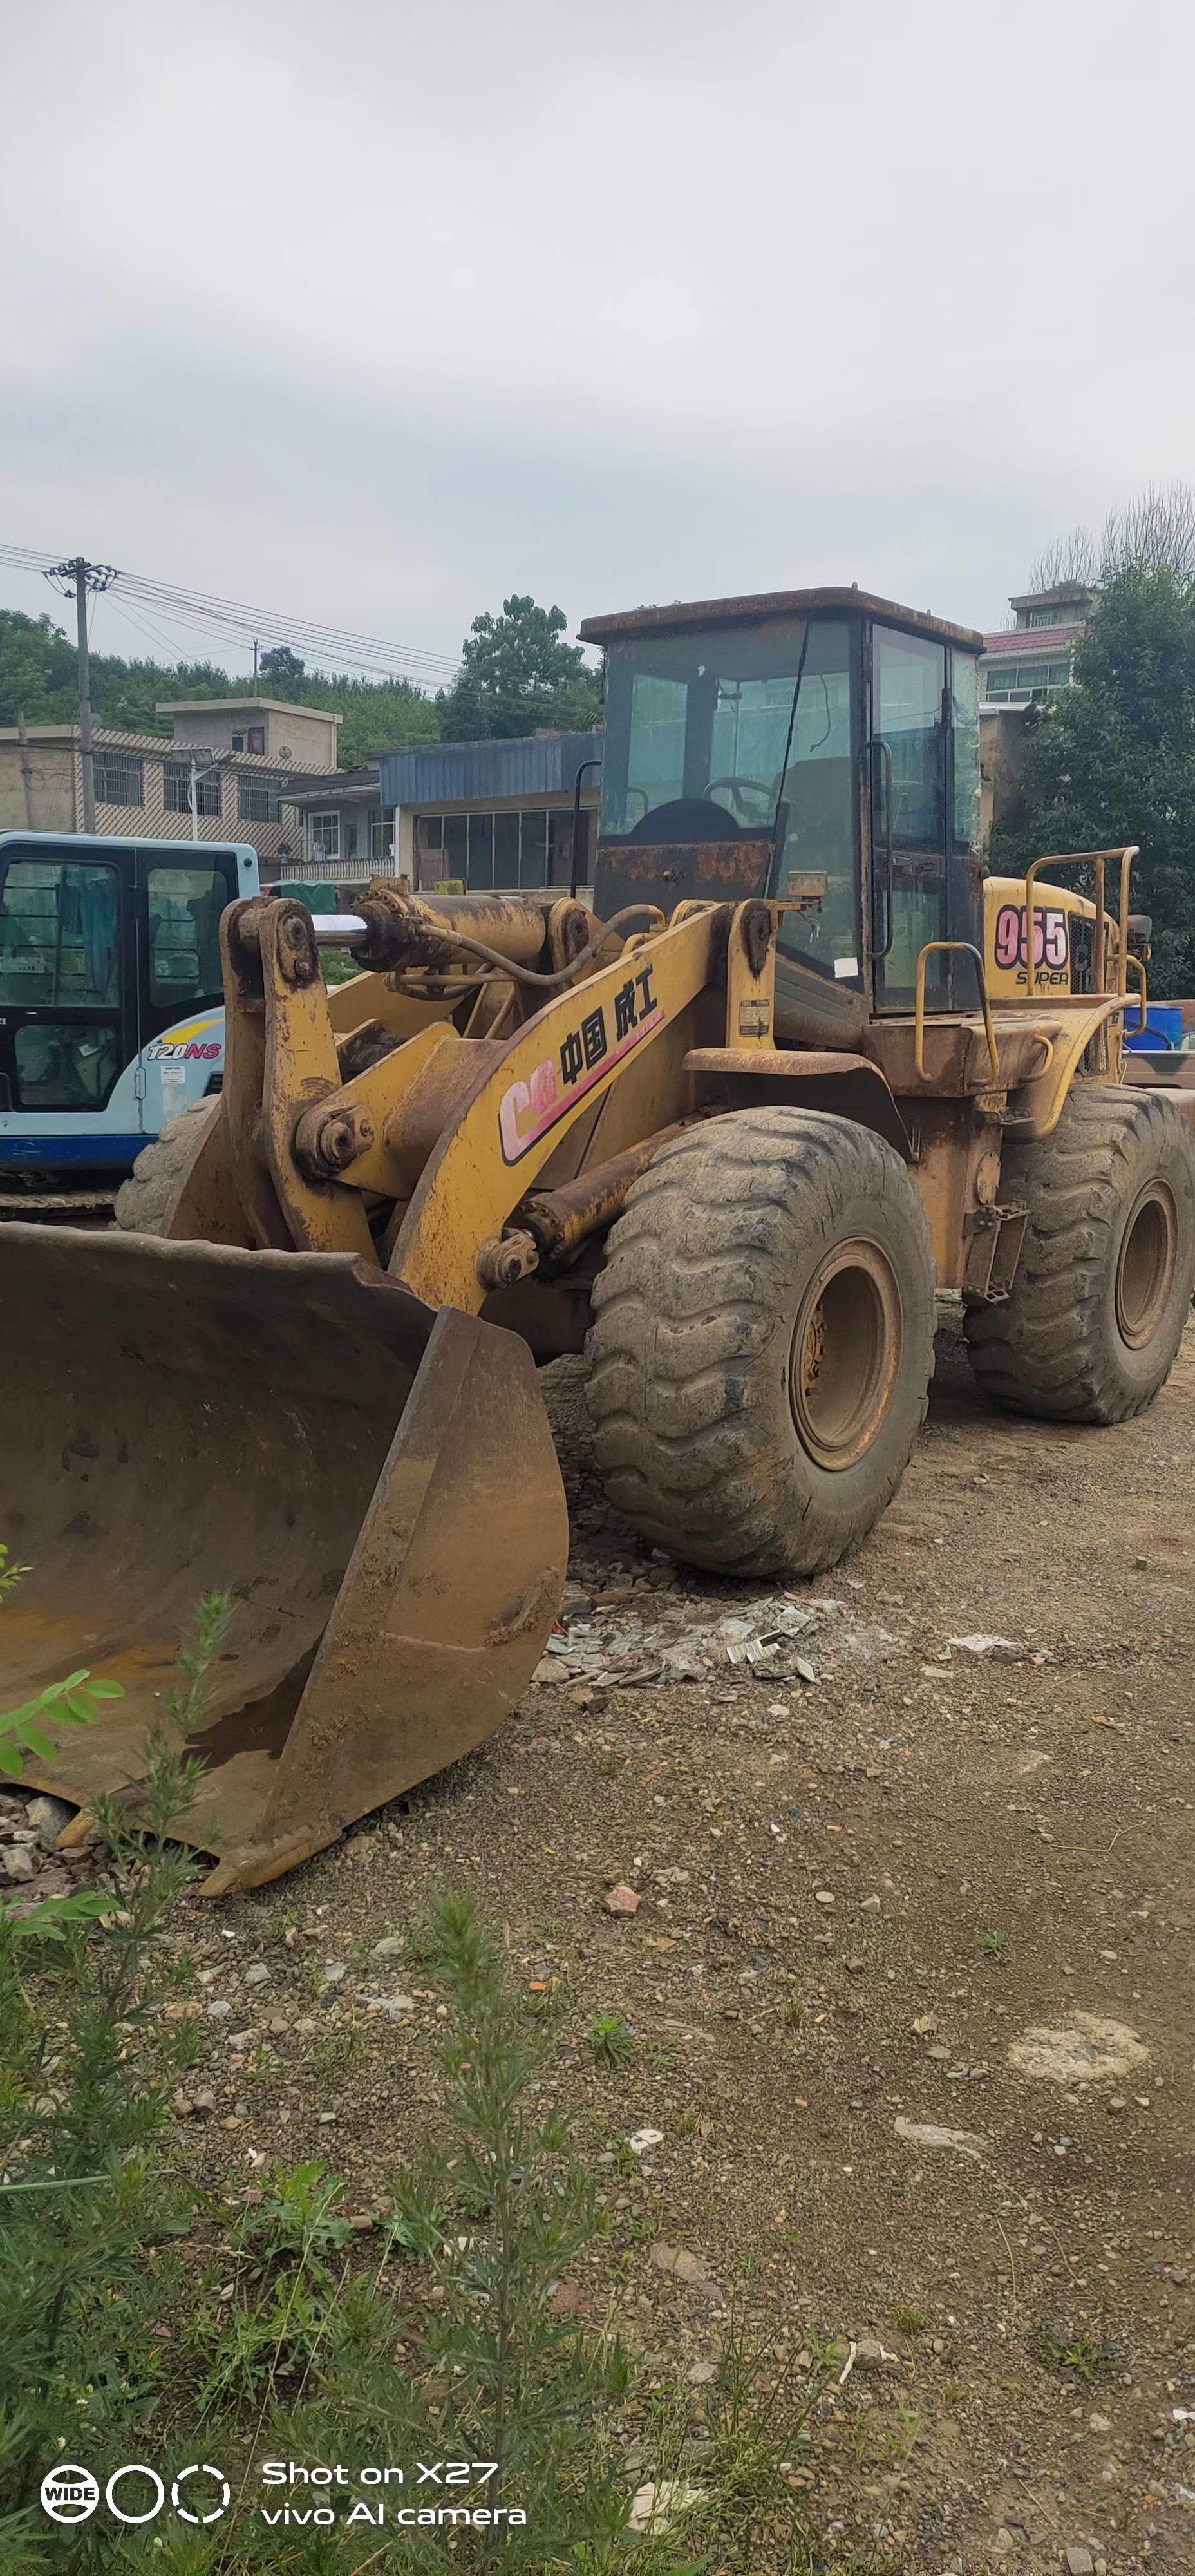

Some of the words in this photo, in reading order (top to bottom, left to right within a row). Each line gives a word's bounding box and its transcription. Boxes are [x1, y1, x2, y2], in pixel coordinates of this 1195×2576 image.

[995, 904, 1068, 970] 955
[147, 1043, 221, 1061] 120NS
[560, 1005, 607, 1085] 中国
